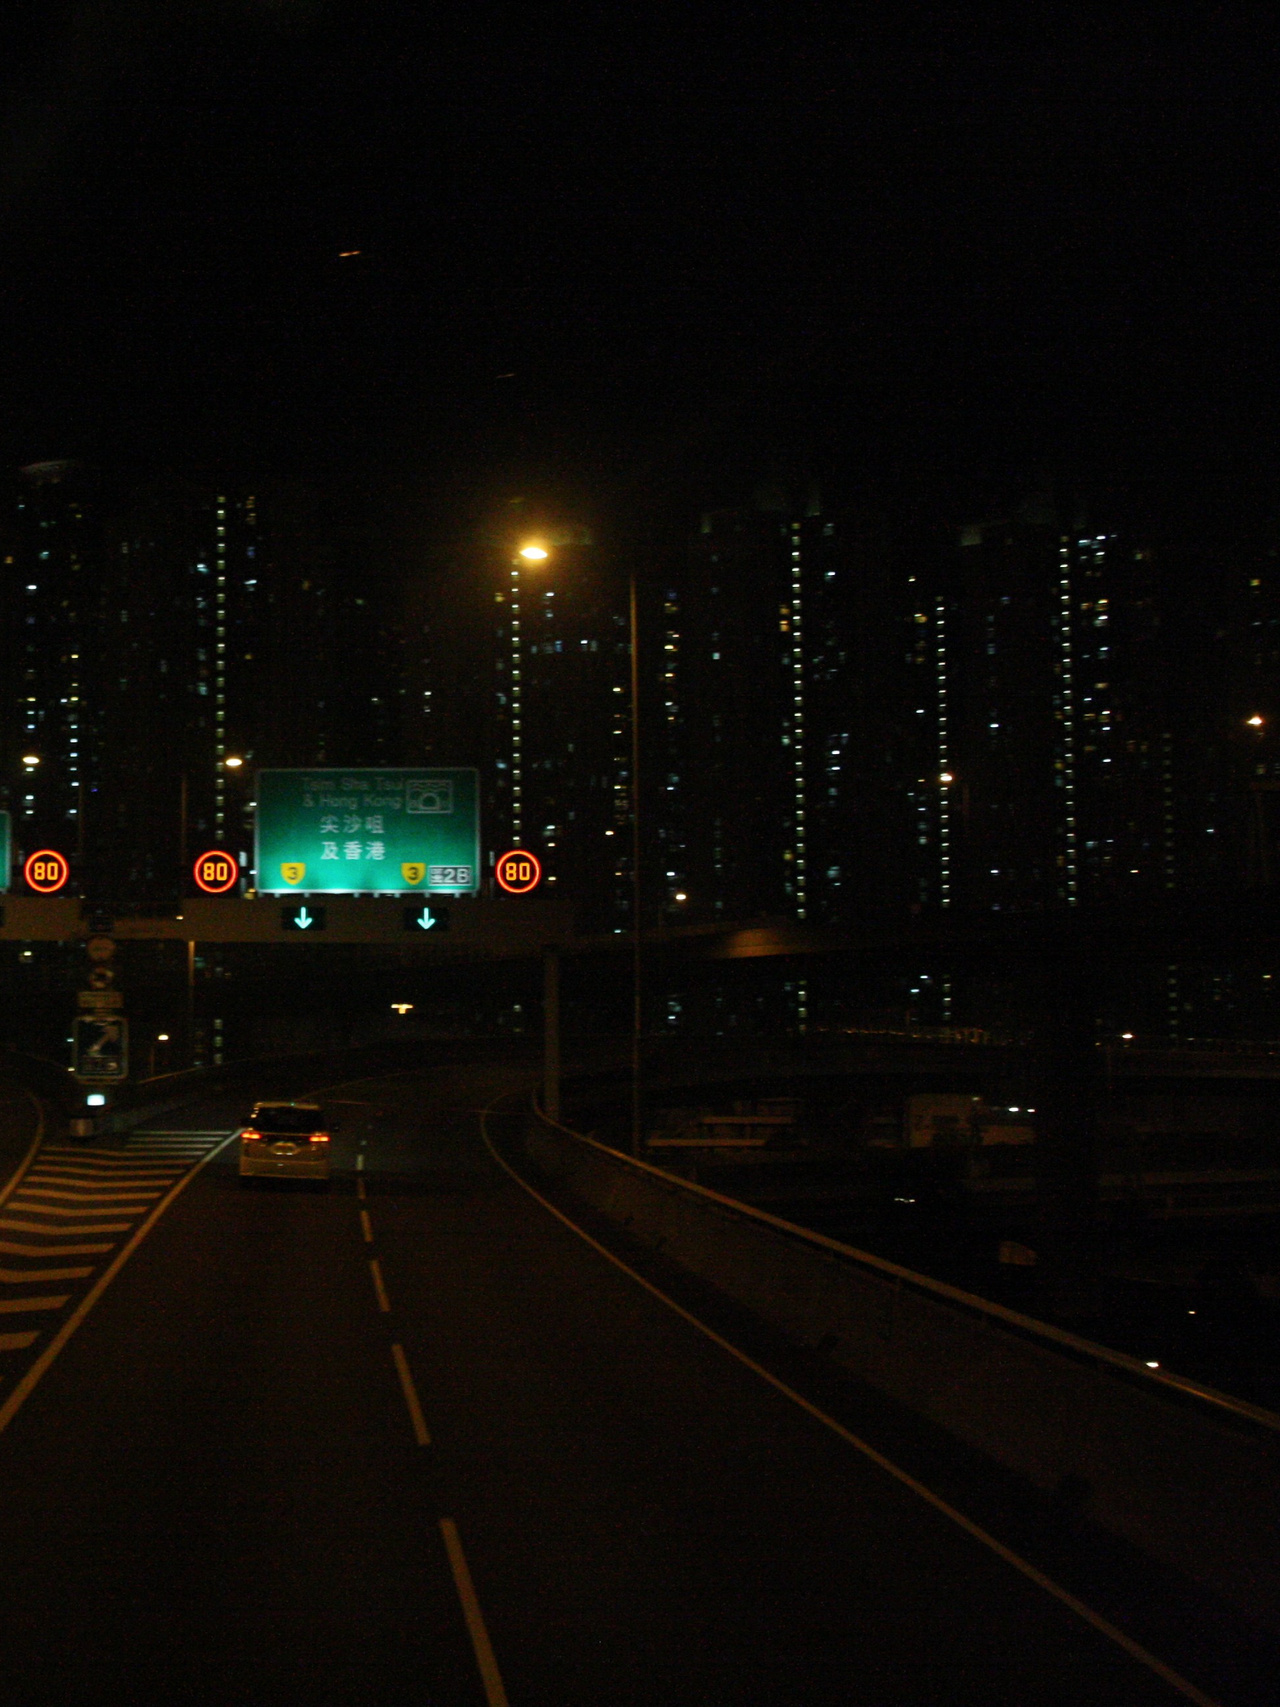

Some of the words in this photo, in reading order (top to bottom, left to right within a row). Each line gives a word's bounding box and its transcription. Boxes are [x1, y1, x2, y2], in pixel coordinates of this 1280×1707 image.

[319, 794, 358, 810] Hong
[363, 794, 402, 810] Kong
[320, 814, 385, 834] 尖沙咀
[320, 840, 386, 861] 及香港
[34, 861, 58, 881] 80
[203, 862, 228, 881] 80
[287, 867, 297, 881] 3
[408, 867, 419, 881] 3
[443, 868, 469, 883] 2B
[505, 862, 530, 881] 80
